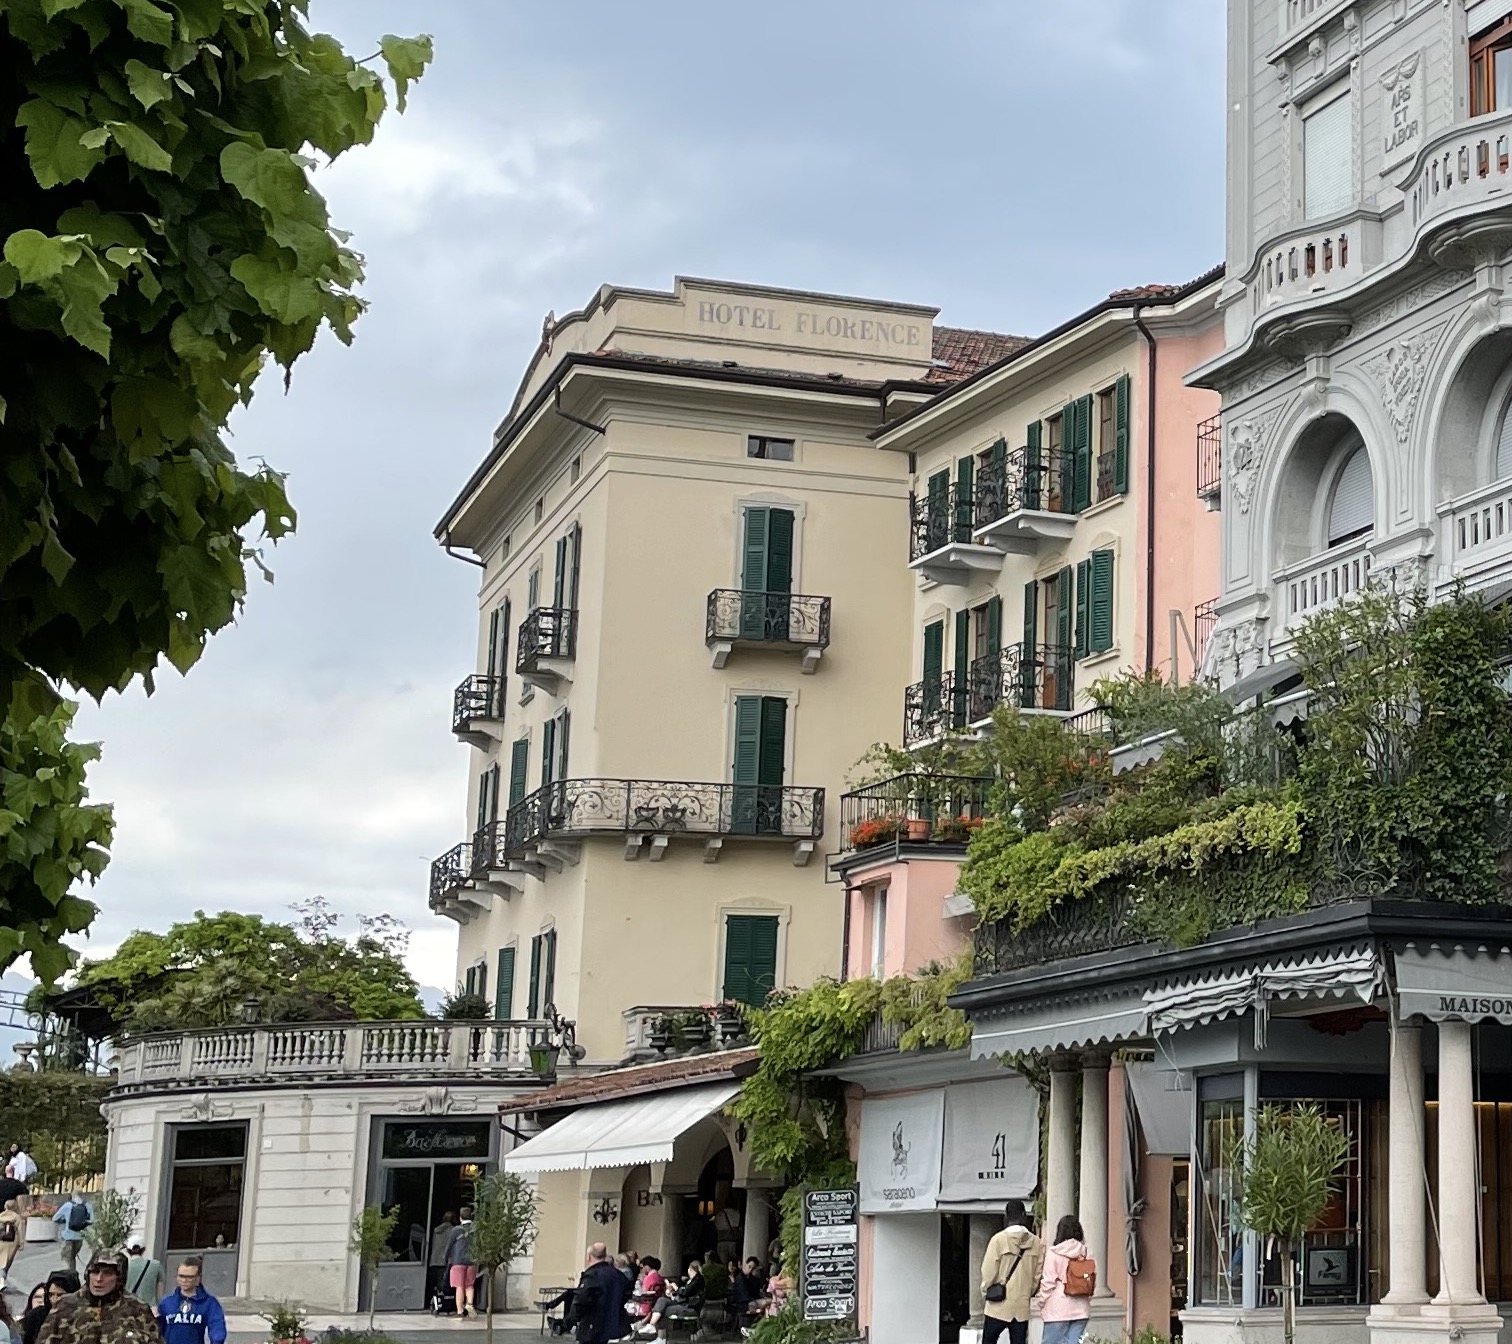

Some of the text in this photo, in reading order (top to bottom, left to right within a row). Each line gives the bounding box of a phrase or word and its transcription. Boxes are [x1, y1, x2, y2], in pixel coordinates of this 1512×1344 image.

[698, 301, 921, 346] HOTEL FLORENCE
[992, 1132, 1006, 1169] 41
[638, 1190, 663, 1206] BA
[831, 1192, 852, 1201] Sport
[807, 1297, 852, 1308] Arco Sport
